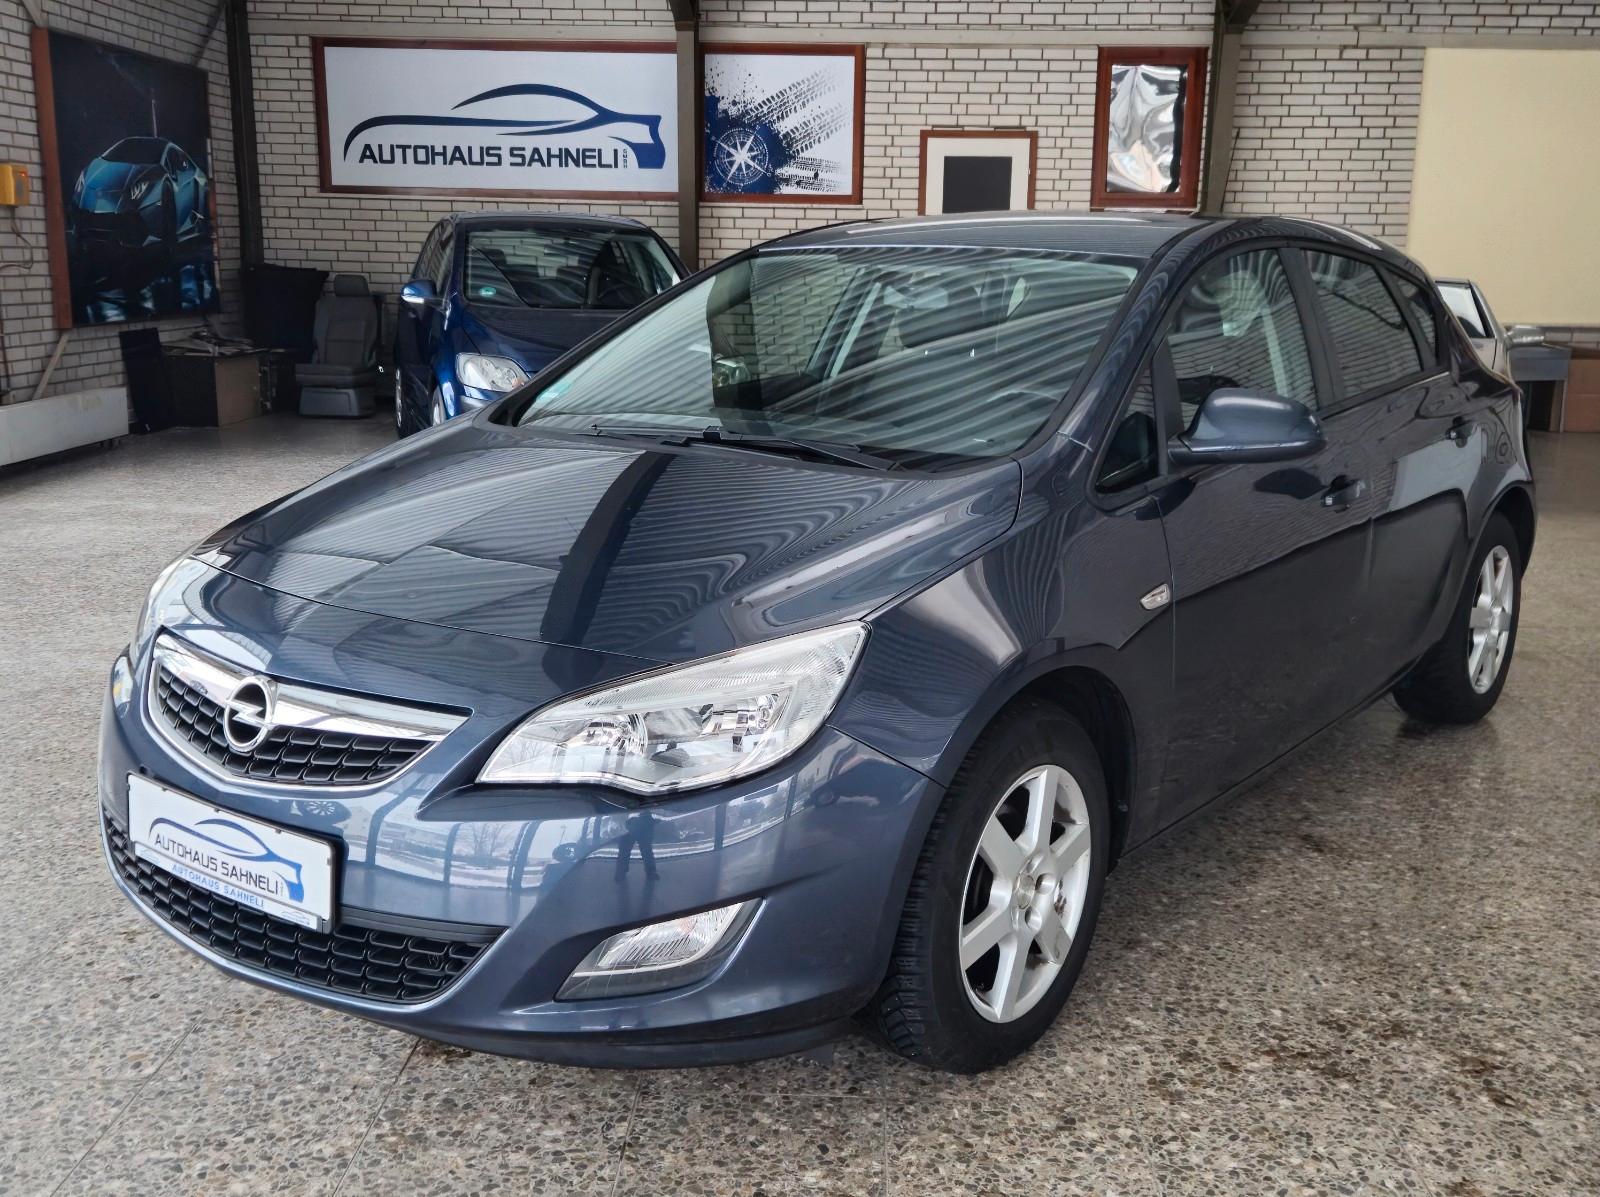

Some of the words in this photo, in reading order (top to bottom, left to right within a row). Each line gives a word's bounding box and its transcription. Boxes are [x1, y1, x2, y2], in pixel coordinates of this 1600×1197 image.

[359, 143, 503, 167] AUTOHAUS
[509, 146, 619, 169] SAHNELI
[154, 833, 218, 873] AUTOHAUS
[221, 860, 279, 896] SAHNELI
[172, 864, 220, 891] AUTOHAUS
[223, 884, 265, 908] SAHNELI
